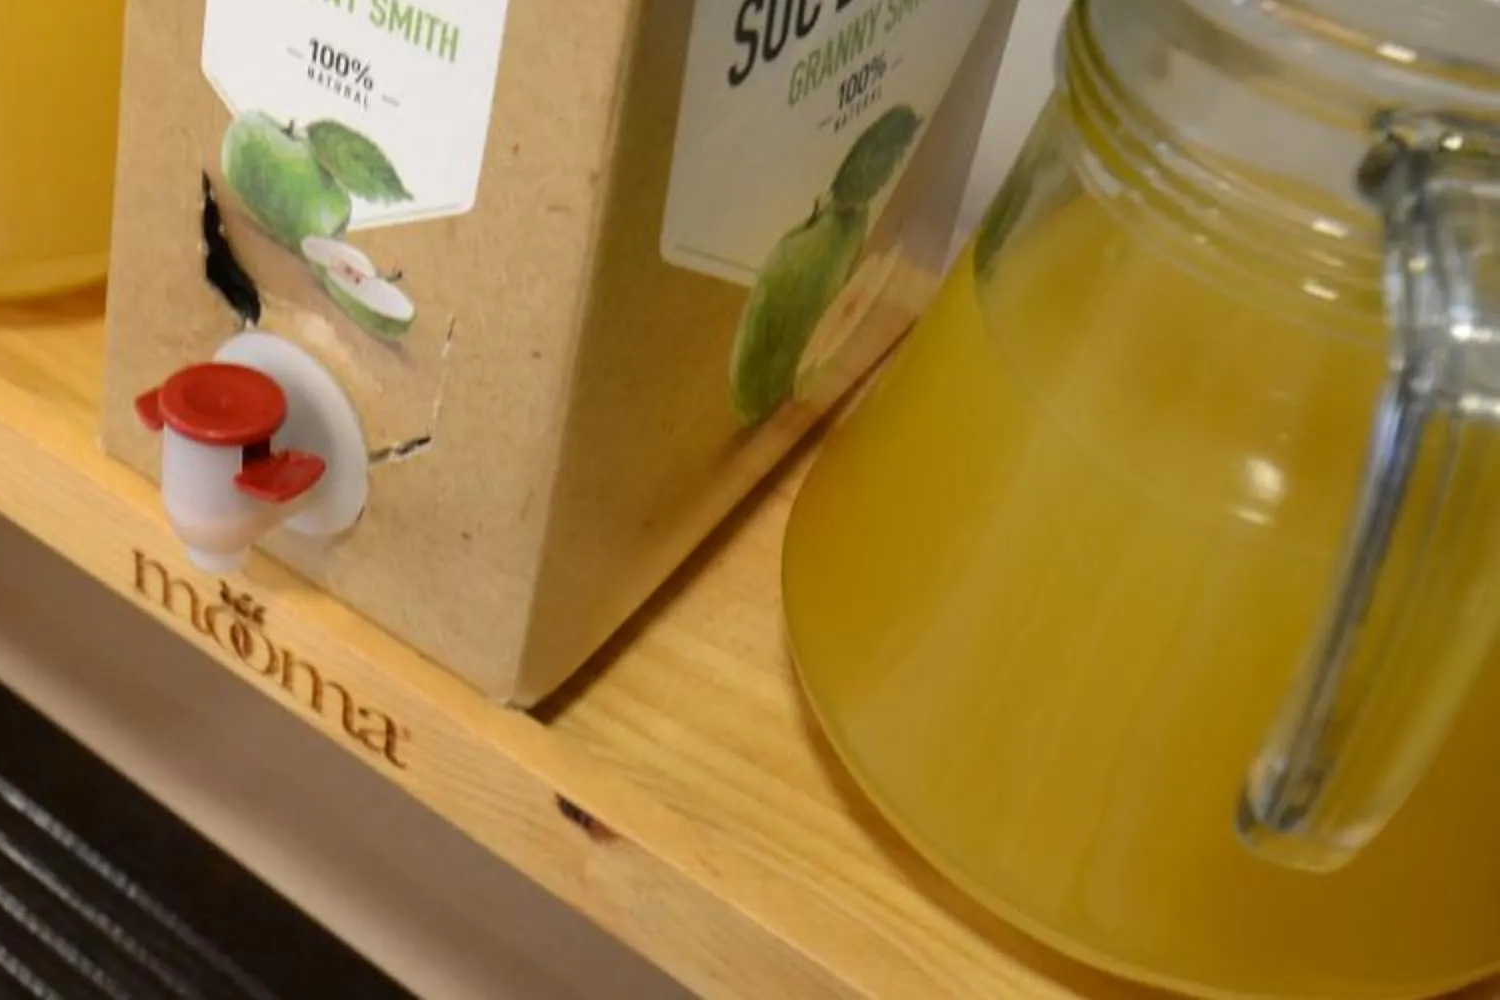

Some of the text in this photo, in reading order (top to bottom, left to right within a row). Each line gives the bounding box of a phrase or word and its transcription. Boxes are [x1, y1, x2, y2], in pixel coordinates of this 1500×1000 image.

[309, 37, 373, 91] 100%
[788, 0, 882, 108] GRANNY
[839, 50, 887, 110] 100%
